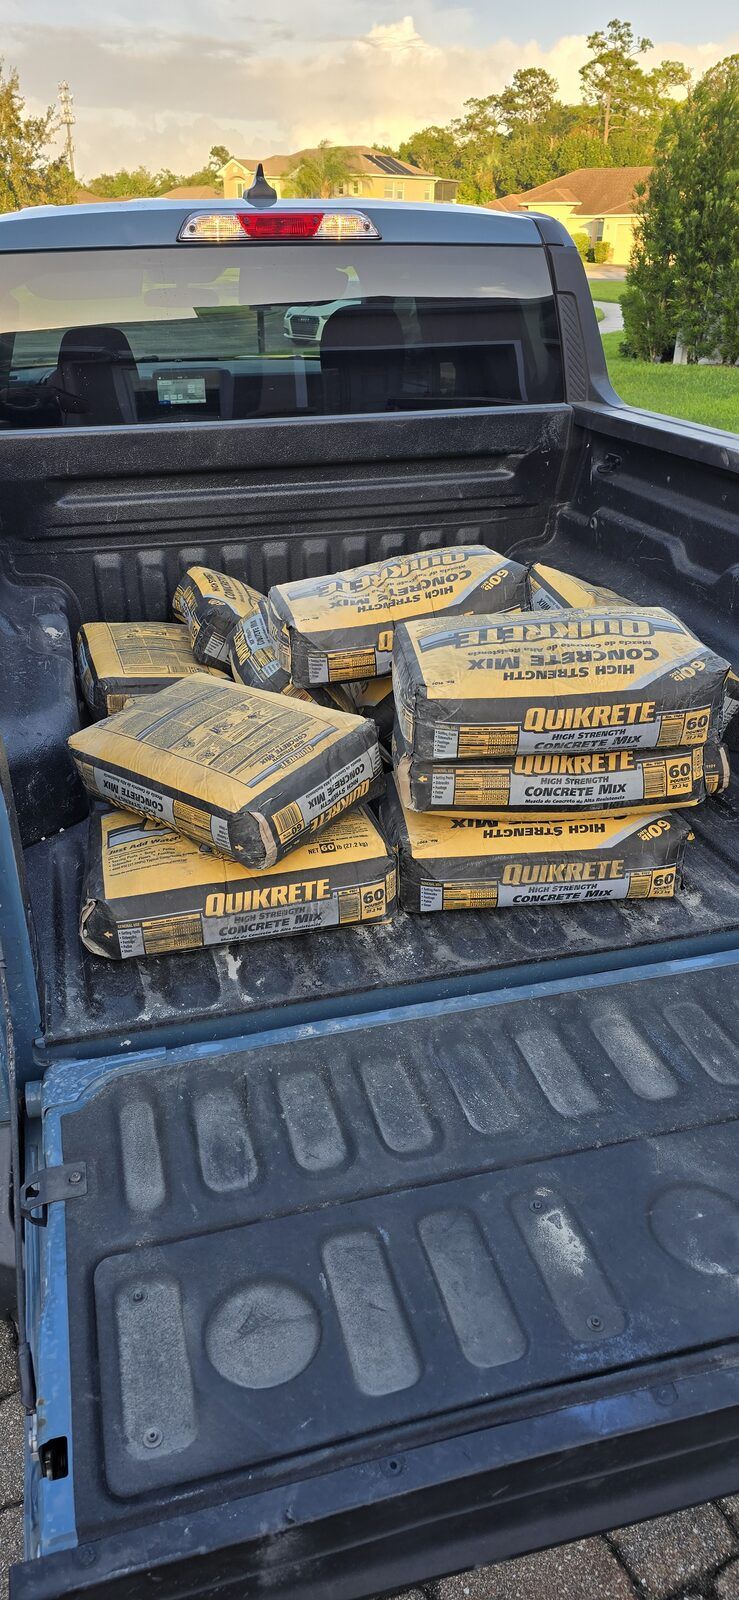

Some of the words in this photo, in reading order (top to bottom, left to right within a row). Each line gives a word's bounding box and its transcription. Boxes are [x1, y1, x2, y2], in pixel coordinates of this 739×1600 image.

[425, 585, 454, 599] HIGH
[456, 619, 652, 648] QUIKRETE
[468, 655, 519, 670] MIX
[530, 648, 660, 666] CONCRETE
[503, 667, 589, 680] STRENGTH
[596, 664, 634, 675] HIGH
[523, 701, 656, 732] QUIKRETE
[686, 715, 709, 731] 60
[551, 733, 576, 741] HIGH
[578, 728, 626, 739] STRENGTH
[534, 738, 608, 750] CONCRETE
[612, 735, 642, 745] MIX
[514, 751, 635, 776] QUIKRETE
[669, 762, 691, 778] 60
[103, 780, 119, 794] MIX
[327, 763, 365, 796] CONCRETE
[540, 777, 562, 785] HIGH
[565, 776, 609, 784] STRENGTH
[524, 786, 593, 797] CONCRETE
[598, 783, 627, 793] MIX
[121, 786, 164, 812] CONCRETE
[308, 792, 326, 809] MIX
[291, 823, 302, 835] 60
[450, 818, 499, 829] MIX
[568, 823, 606, 834] HIGH
[483, 826, 563, 838] STRENGTH
[129, 841, 149, 850] Add
[151, 835, 182, 846] Water!
[320, 844, 336, 853] 60
[358, 841, 368, 849] kg)
[502, 859, 624, 885] QUIKRETE
[653, 872, 674, 887] 60
[551, 883, 598, 892] STRENGTH
[204, 878, 331, 917] QUIKRETE
[362, 888, 385, 904] 60
[512, 892, 582, 903] CONCRETE
[585, 889, 613, 898] MIX
[234, 915, 256, 924] HIGH
[259, 906, 306, 920] STRENGTH
[218, 918, 290, 937] CONCRETE
[294, 911, 323, 925] MIX
